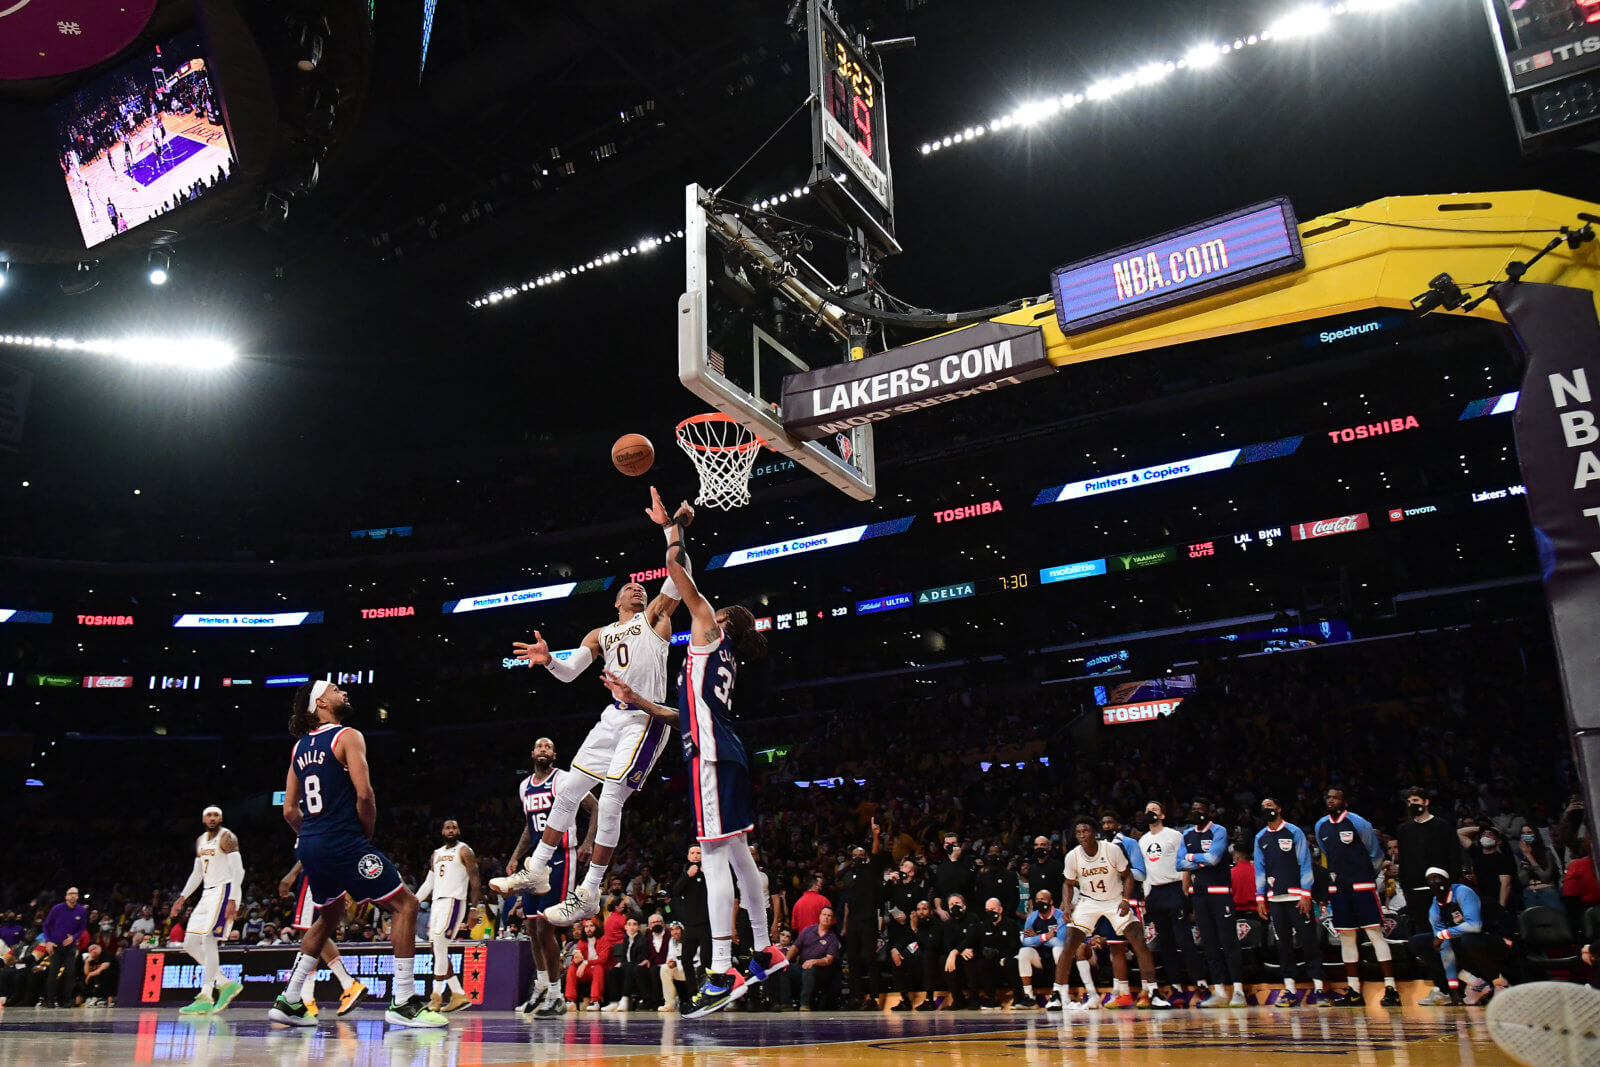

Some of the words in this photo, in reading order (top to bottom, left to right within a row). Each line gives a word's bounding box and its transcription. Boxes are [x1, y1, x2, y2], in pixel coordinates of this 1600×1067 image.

[836, 42, 874, 108] 3:23
[1112, 237, 1229, 301] NBA.com
[1320, 321, 1379, 343] Spectrum
[812, 340, 1014, 416] LAKERS.COM
[1328, 415, 1419, 444] TOSHIBA
[757, 460, 795, 476] DELTA
[1084, 476, 1129, 491] Printers
[1131, 474, 1140, 483] &
[1143, 464, 1191, 481] Copiers
[1472, 489, 1507, 502] Lakers
[933, 499, 1003, 523] TOSHIBA
[1404, 505, 1437, 517] TOYOTA
[1234, 533, 1252, 544] LAL
[1258, 528, 1282, 540] BKN
[746, 548, 780, 560] Printers
[782, 544, 789, 552] &
[791, 538, 828, 551] Copiers
[1188, 542, 1213, 552] TIME
[1241, 543, 1247, 551] 1
[1266, 539, 1273, 547] 3
[1189, 549, 1215, 559] OUTS
[998, 573, 1028, 590] 7:30
[472, 597, 502, 607] Printers
[511, 591, 543, 602] Copiers
[931, 586, 973, 600] DELTA
[886, 597, 911, 607] ULTRA
[77, 615, 134, 626] TOSHIBA
[360, 606, 415, 619] TOSHIBA
[198, 616, 229, 625] Printers
[241, 616, 274, 626] Copiers
[754, 618, 771, 631] BA
[777, 621, 791, 630] LAL
[617, 642, 630, 670] 0
[297, 749, 326, 771] MILLS
[304, 774, 323, 815] 8
[523, 792, 552, 812] NETS
[531, 812, 547, 833] 16
[204, 859, 210, 874] 7
[440, 864, 445, 877] 6
[1081, 866, 1109, 877] LAKERS
[1089, 879, 1110, 893] 14
